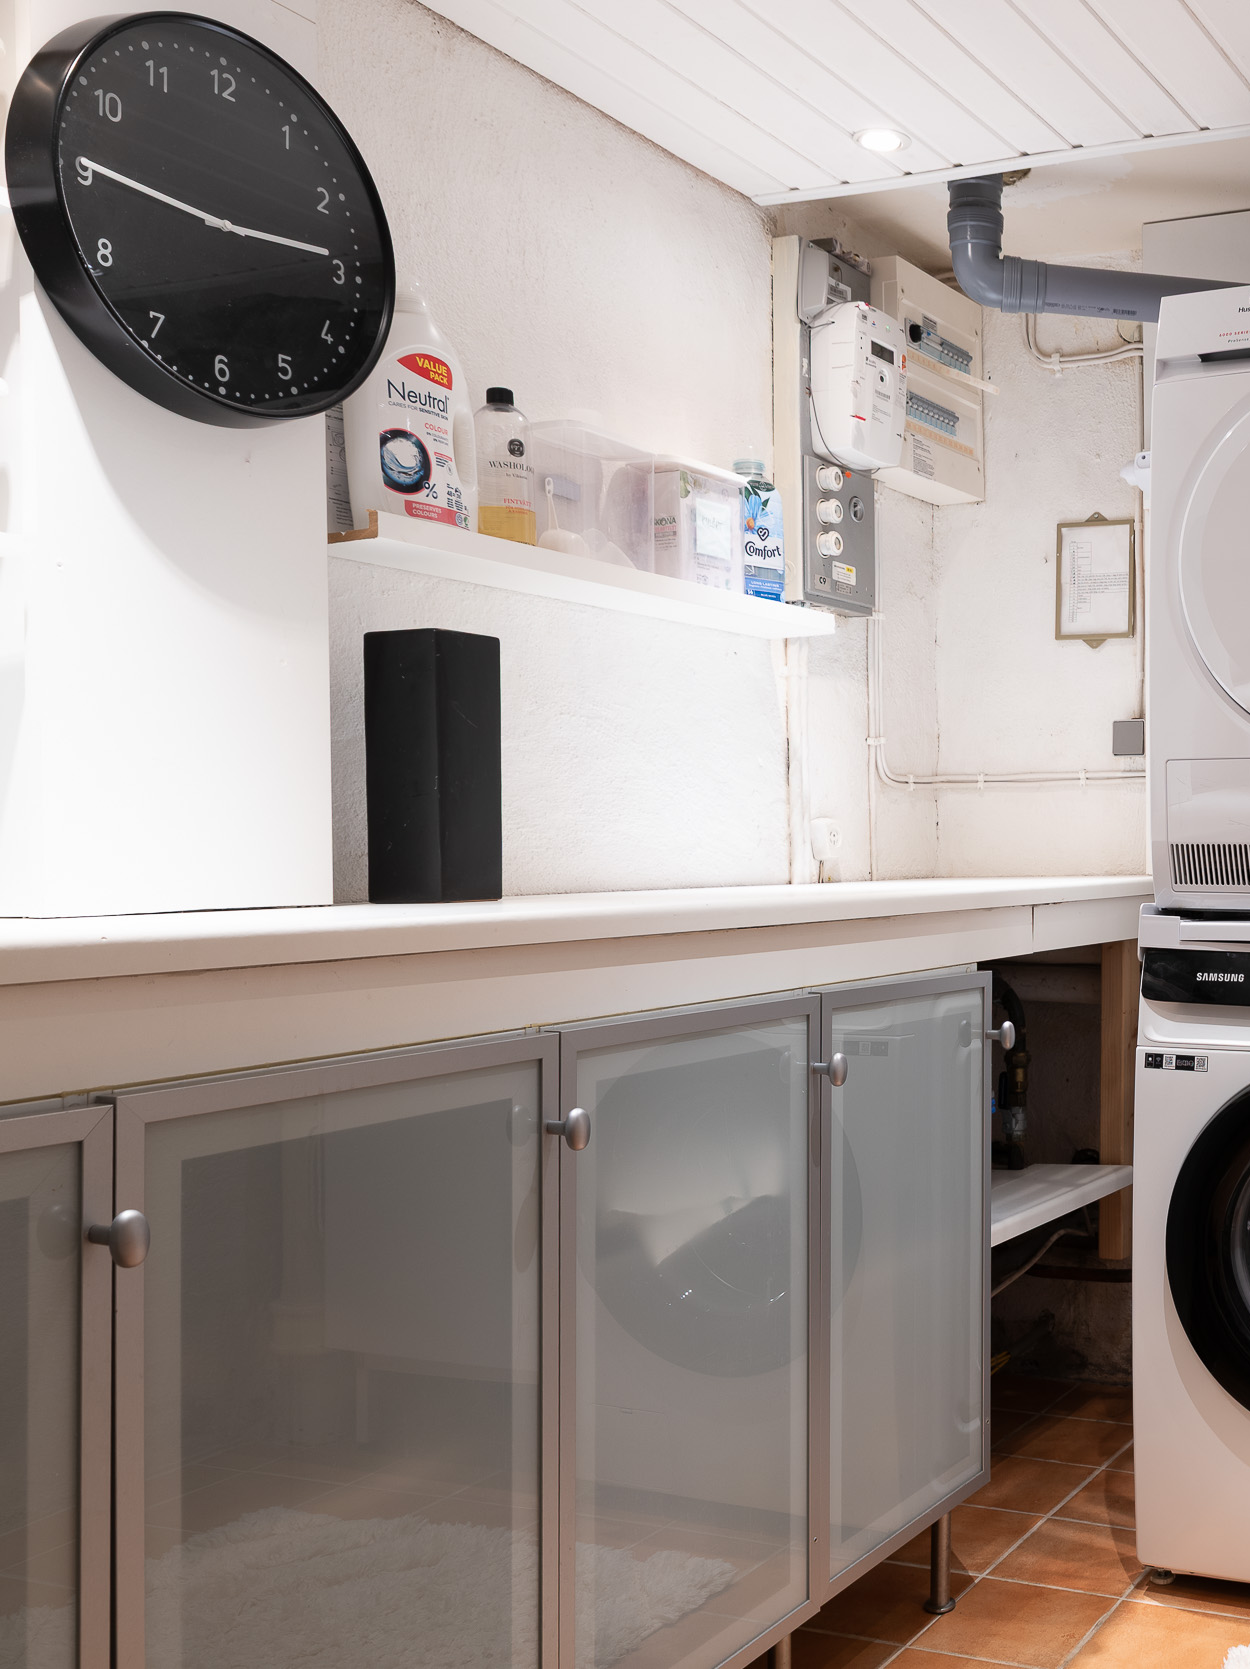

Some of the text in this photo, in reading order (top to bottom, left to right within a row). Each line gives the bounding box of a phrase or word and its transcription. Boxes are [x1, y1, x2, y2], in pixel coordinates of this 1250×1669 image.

[145, 59, 168, 93] 11
[210, 69, 237, 102] 12
[94, 88, 122, 123] 10
[282, 125, 290, 150] 1
[75, 155, 93, 186] 9
[316, 187, 330, 214] 2
[97, 238, 113, 267] 8
[332, 260, 345, 284] 3
[149, 311, 165, 338] 7
[321, 320, 334, 345] 4
[214, 355, 230, 381] 6
[278, 354, 292, 380] 5
[416, 356, 448, 377] VALUE
[430, 371, 448, 386] PACK
[387, 378, 449, 414] Neutral
[388, 401, 406, 409] CARES
[418, 407, 440, 417] SENSITIVE
[424, 422, 448, 436] COLOUR
[412, 503, 442, 514] PRESERVES
[412, 509, 438, 518] COLOURS
[744, 541, 782, 560] Comfort
[819, 576, 827, 585] C9
[1196, 972, 1245, 982] SAMSUNG
